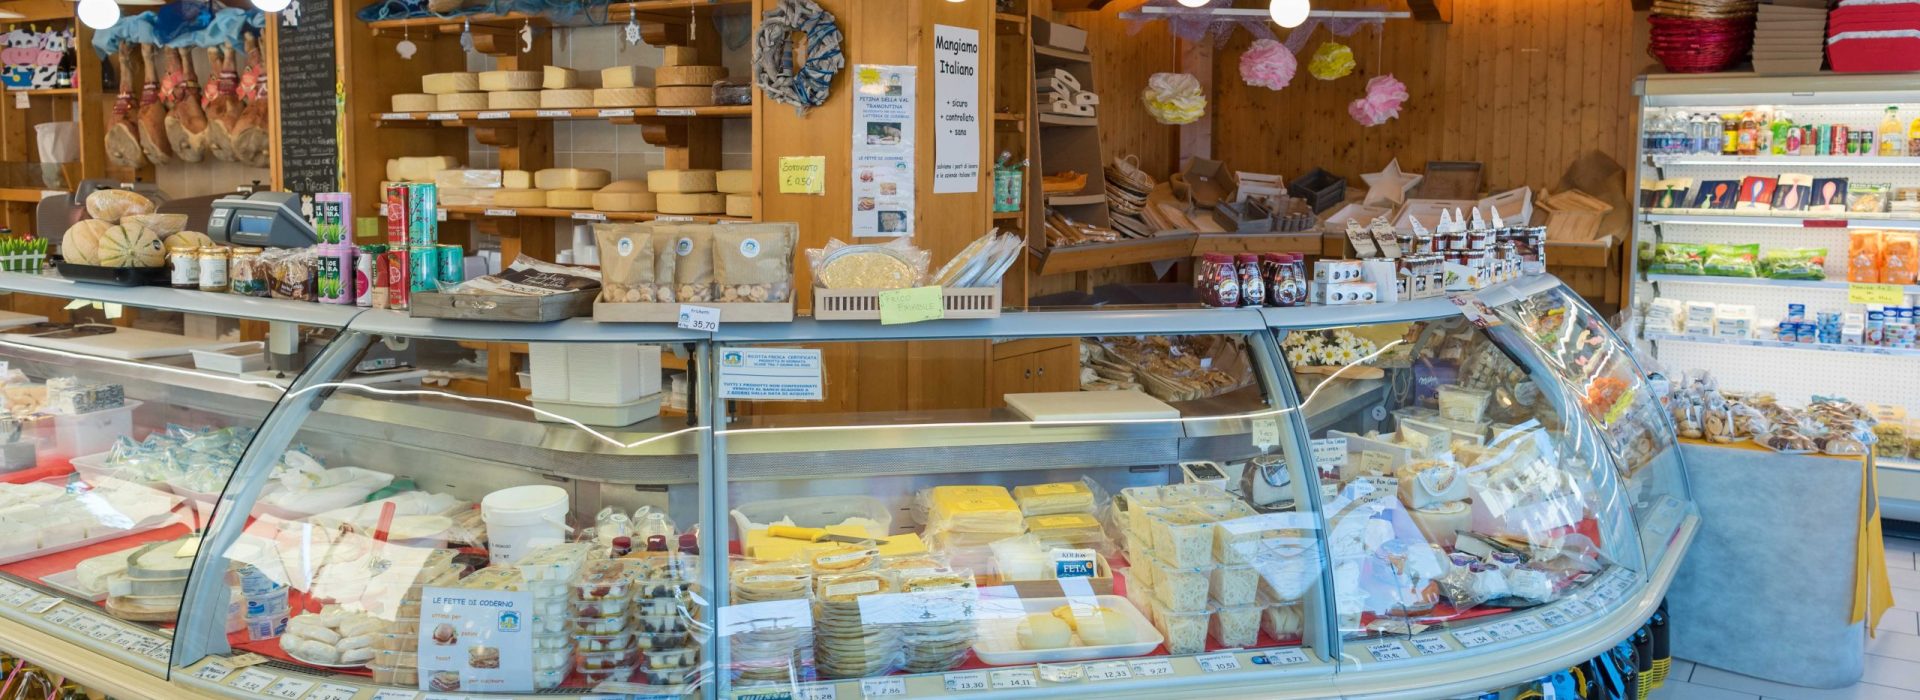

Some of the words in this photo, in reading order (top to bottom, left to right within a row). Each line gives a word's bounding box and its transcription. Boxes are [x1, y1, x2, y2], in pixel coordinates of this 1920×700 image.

[936, 36, 978, 55] Mangiamo
[940, 60, 974, 76] Italiano
[952, 100, 968, 108] sicuro
[946, 113, 974, 122] controllato
[693, 321, 716, 329] 35,70
[1419, 376, 1438, 386] Milka
[1064, 564, 1087, 572] FETA
[1216, 662, 1235, 670] 10,51
